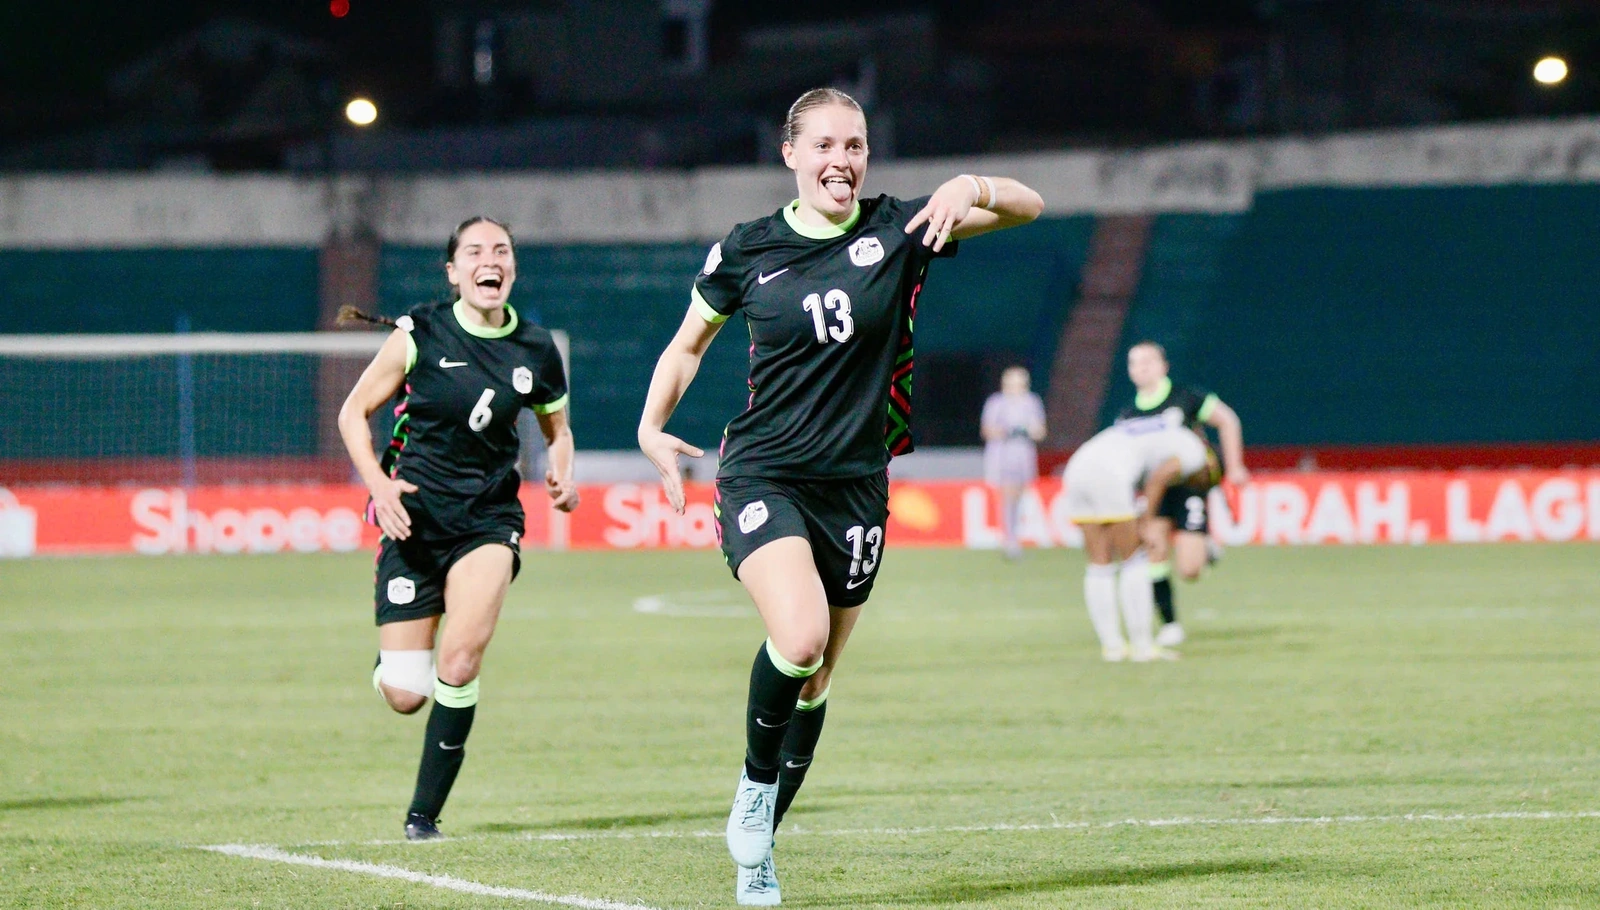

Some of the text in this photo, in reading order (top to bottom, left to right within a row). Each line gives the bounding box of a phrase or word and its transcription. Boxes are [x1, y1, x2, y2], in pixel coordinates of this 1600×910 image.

[803, 289, 854, 344] 13
[468, 388, 496, 432] 6
[130, 488, 362, 554] Shopee
[846, 525, 883, 576] 13
